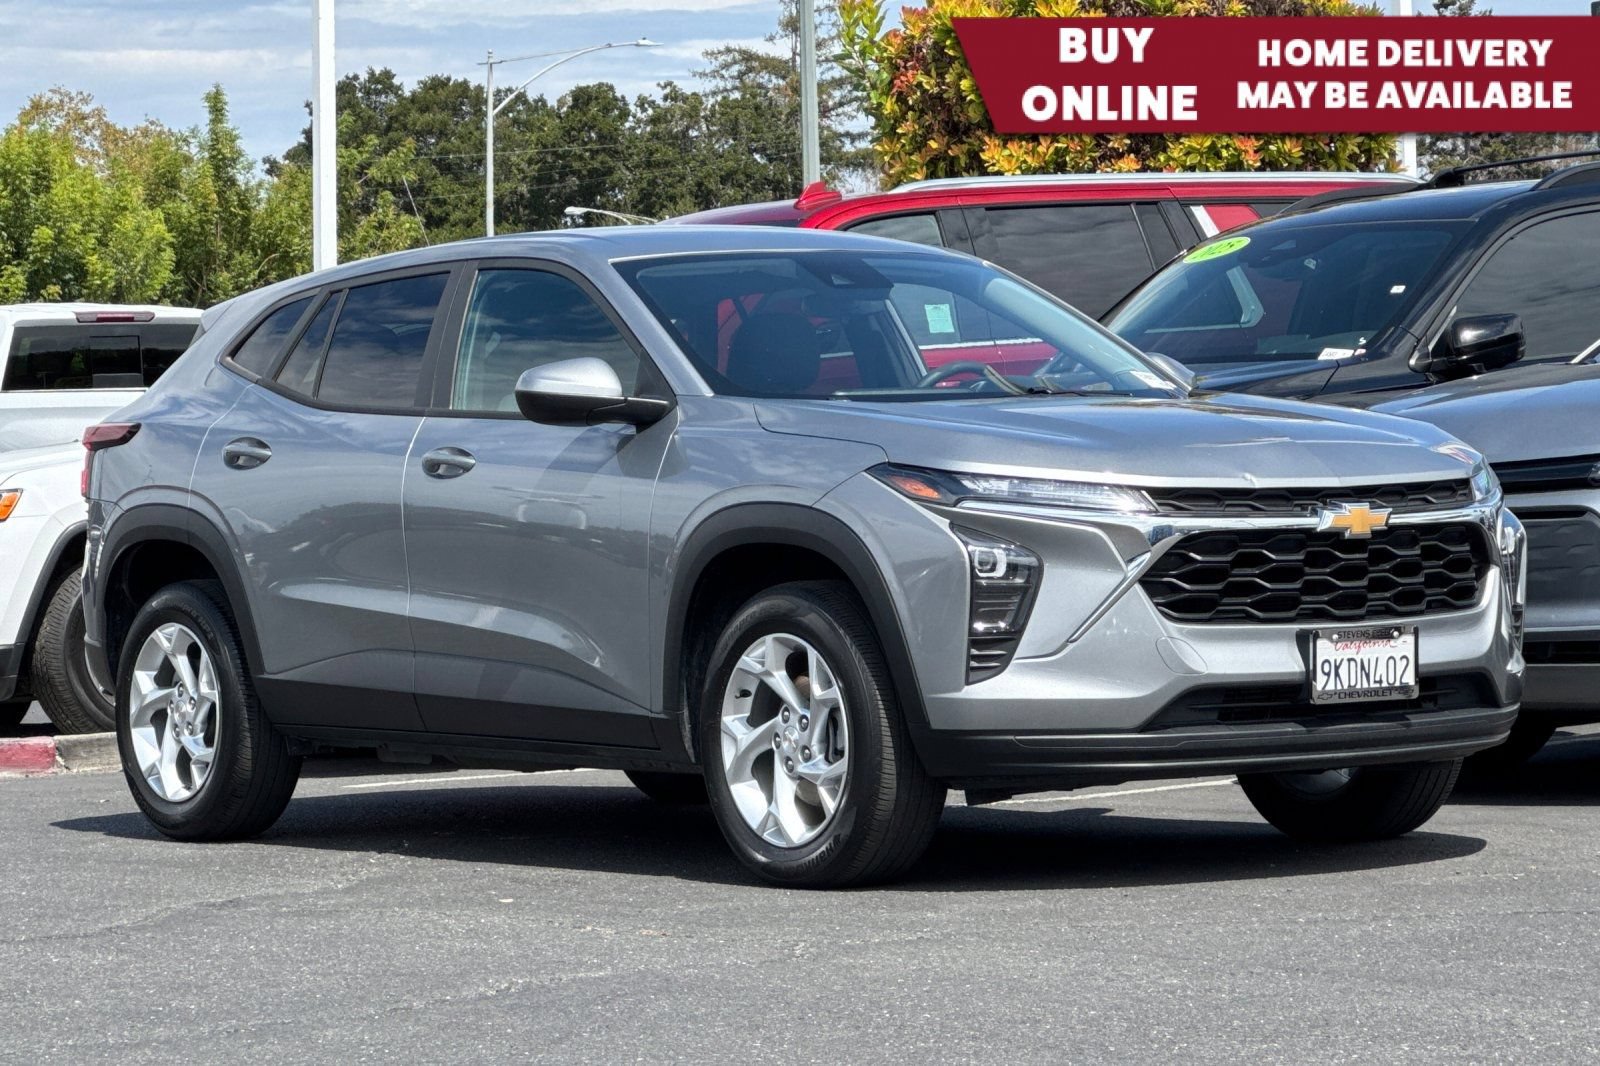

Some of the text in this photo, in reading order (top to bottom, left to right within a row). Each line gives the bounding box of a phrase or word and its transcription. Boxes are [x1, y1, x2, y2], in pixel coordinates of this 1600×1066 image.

[1338, 630, 1371, 640] STEVENS
[1335, 639, 1392, 655] California
[1320, 655, 1410, 690] 9KDN402
[1338, 688, 1393, 700] CHEVROLET
